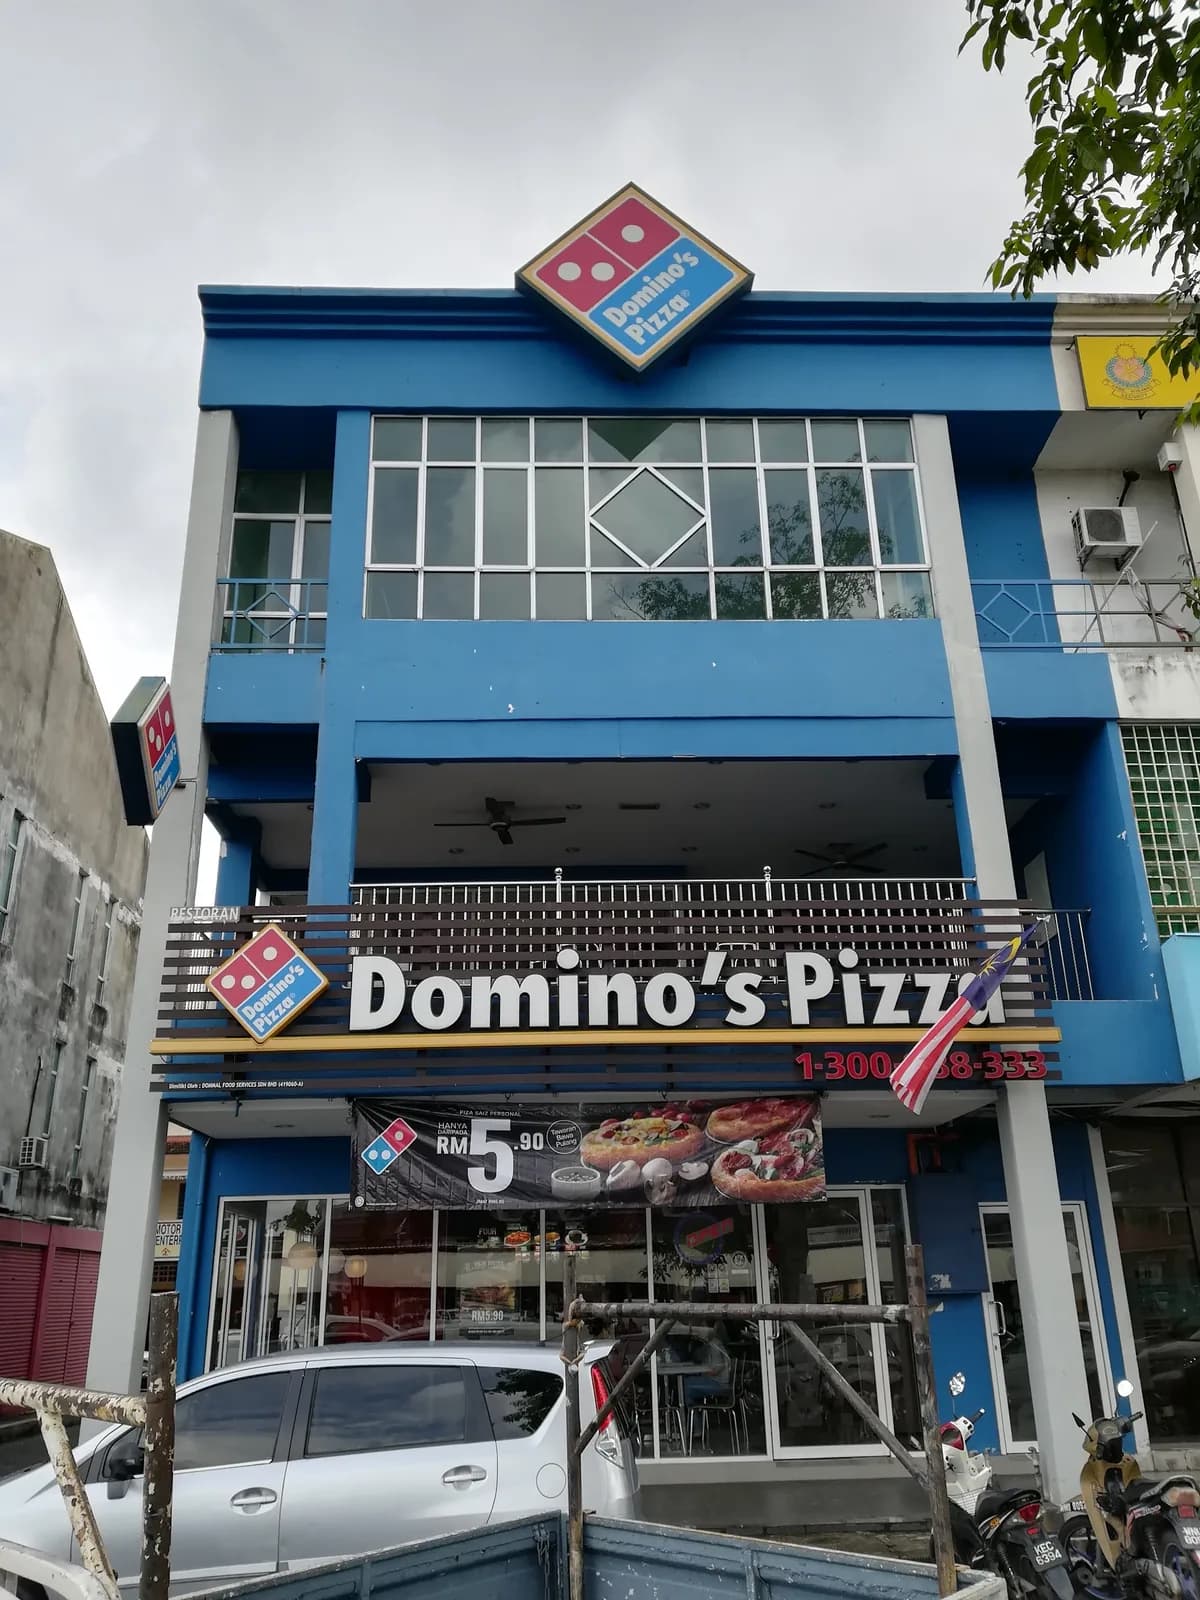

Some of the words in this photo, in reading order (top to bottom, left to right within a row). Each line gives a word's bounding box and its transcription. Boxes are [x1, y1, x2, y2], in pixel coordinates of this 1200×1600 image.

[602, 251, 699, 328] Domino's
[170, 906, 239, 921] RESTORAN
[242, 964, 305, 1020] Domino's
[349, 948, 766, 1031] Domino's
[253, 996, 295, 1033] Pizza
[794, 1051, 1048, 1081] 1-300-8-333
[471, 1310, 504, 1321] RM5.90
[1033, 1541, 1054, 1556] KEC
[1036, 1548, 1062, 1566] 6394
